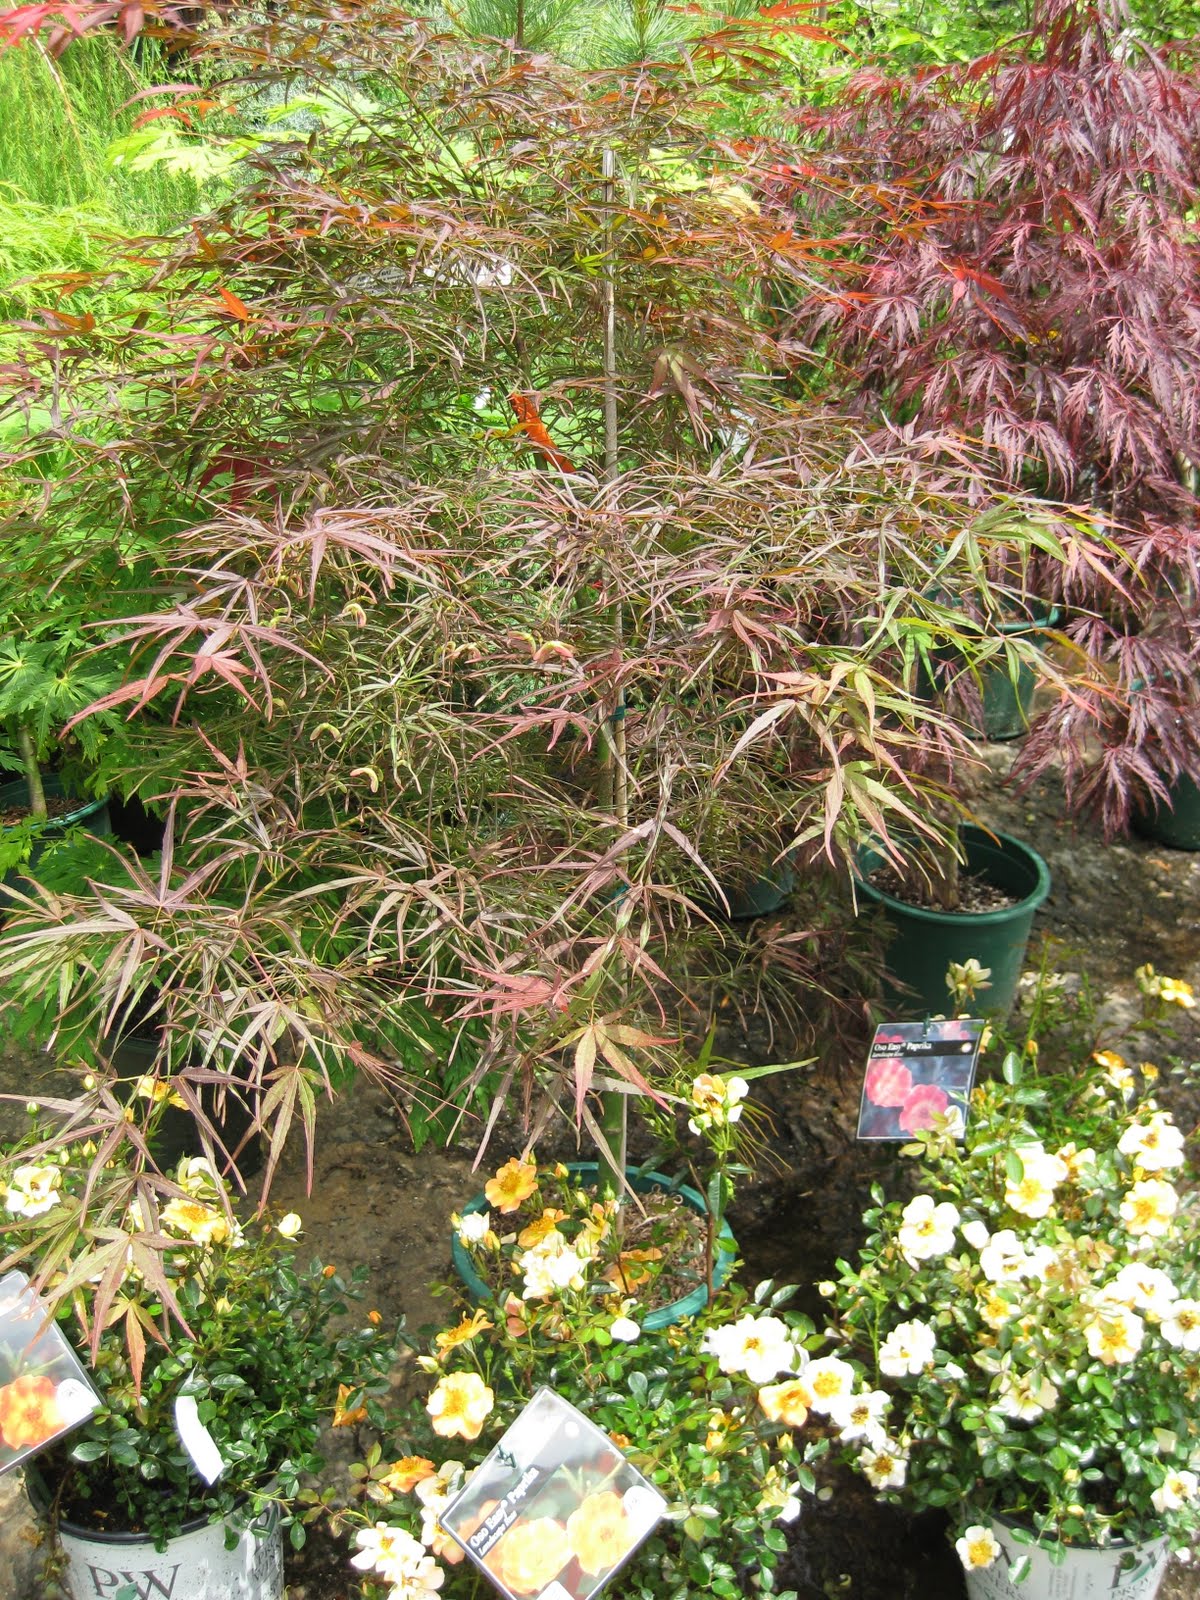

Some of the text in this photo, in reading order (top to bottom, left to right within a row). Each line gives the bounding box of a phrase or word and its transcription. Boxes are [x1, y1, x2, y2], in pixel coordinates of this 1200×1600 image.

[906, 1041, 932, 1051] Paprika
[470, 1527, 489, 1548] Oso
[507, 1467, 540, 1504] Paprika
[83, 1562, 183, 1600] PW
